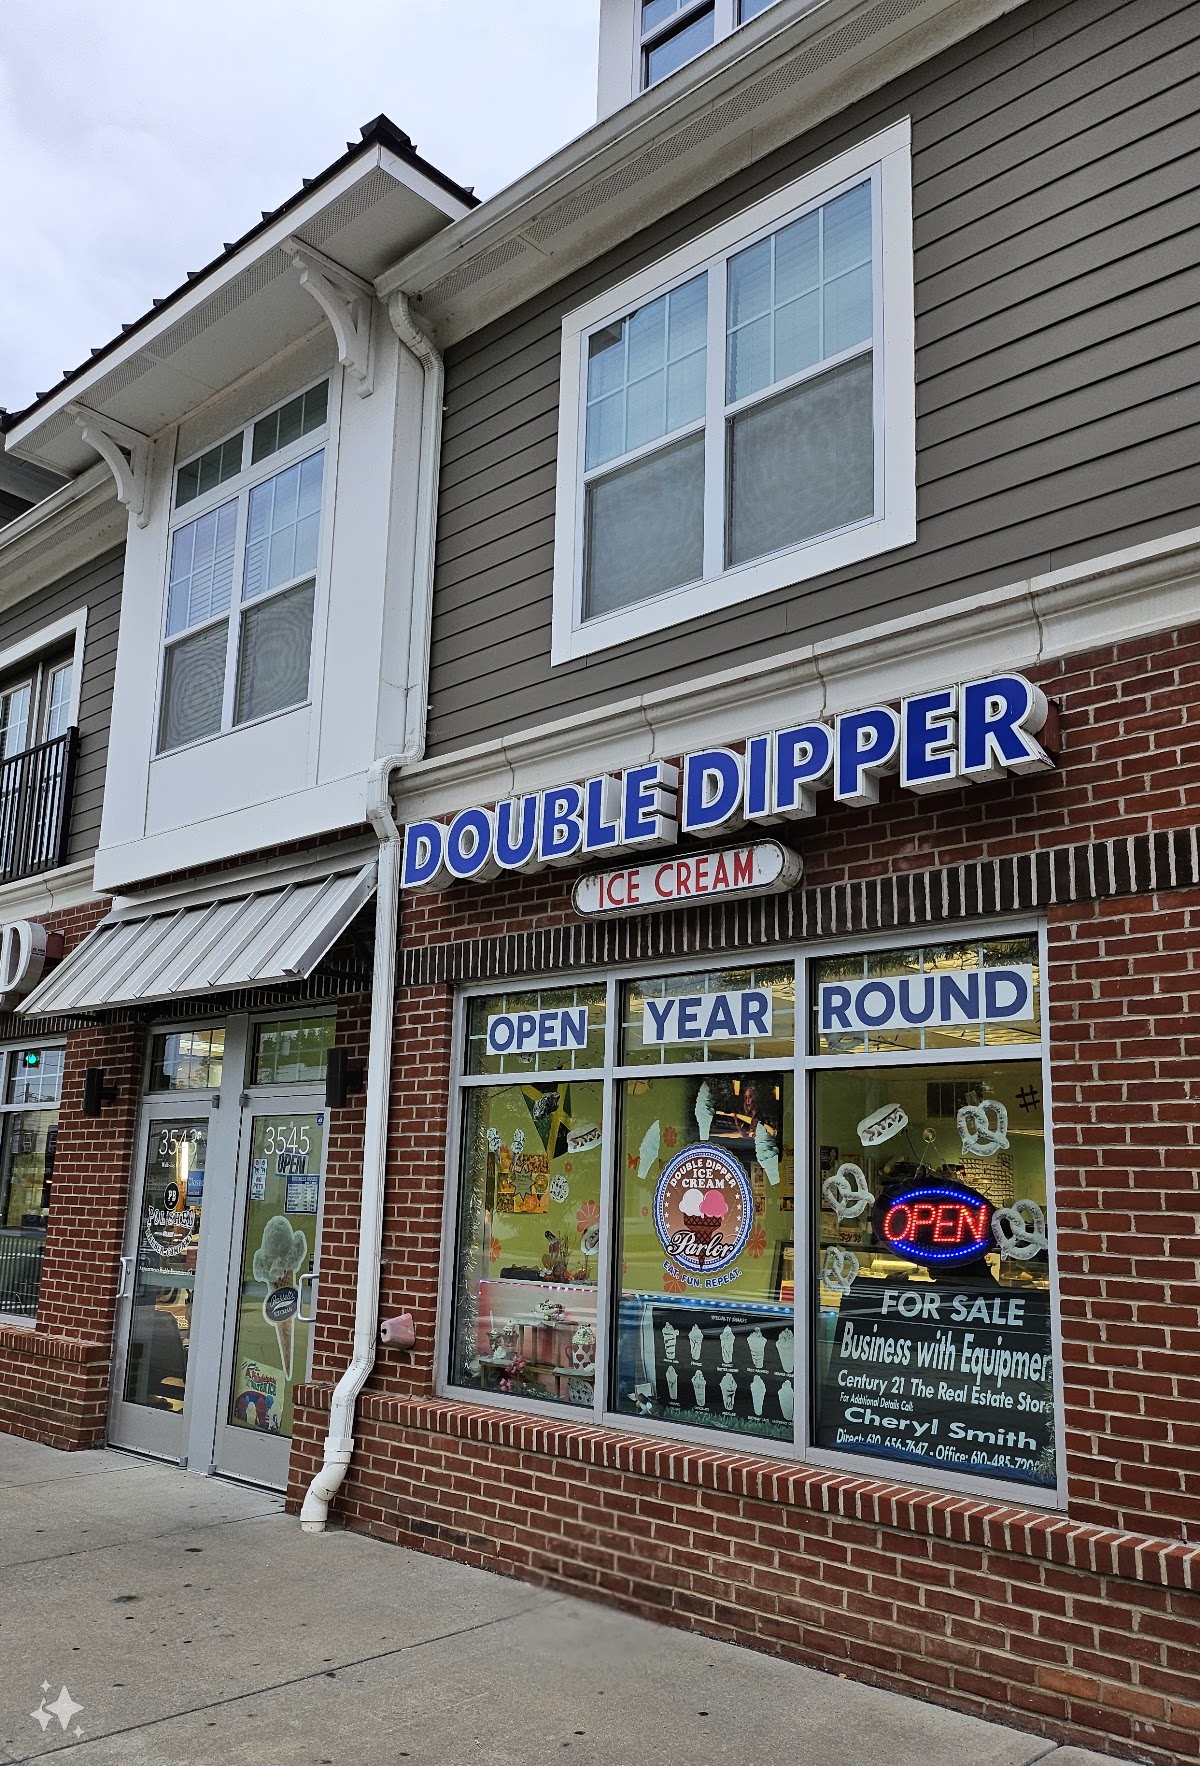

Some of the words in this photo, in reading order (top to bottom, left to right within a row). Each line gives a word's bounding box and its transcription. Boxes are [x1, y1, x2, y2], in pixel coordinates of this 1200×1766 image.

[401, 761, 672, 891] DOUBLE
[682, 671, 1050, 836] DIPPER
[599, 868, 641, 910] ICE
[653, 847, 755, 900] CREAM
[488, 1008, 587, 1052] OPEN
[646, 990, 770, 1042] YEAR
[821, 969, 1029, 1031] ROUND
[159, 1128, 198, 1155] 3543
[263, 1125, 311, 1155] 3545
[669, 1158, 703, 1187] DOUBLE
[705, 1159, 737, 1189] DIPPER
[681, 1178, 725, 1189] CREAM
[692, 1168, 714, 1179] ICE
[883, 1203, 989, 1243] OPEN
[667, 1230, 734, 1259] Parlor
[880, 1289, 941, 1320] FOR
[950, 1294, 1026, 1327] SALE
[839, 1321, 911, 1366] Business
[917, 1329, 956, 1371] with
[960, 1333, 1053, 1387] Equipmen
[837, 1369, 888, 1396] Century
[890, 1376, 905, 1395] 21
[910, 1377, 935, 1399] The
[937, 1381, 968, 1404] Real
[971, 1386, 1014, 1409] Estate
[839, 1391, 850, 1403] For
[850, 1393, 880, 1407] Additional
[880, 1397, 900, 1410] Details
[844, 1406, 939, 1437] Cheryl
[948, 1421, 1037, 1450] Smith
